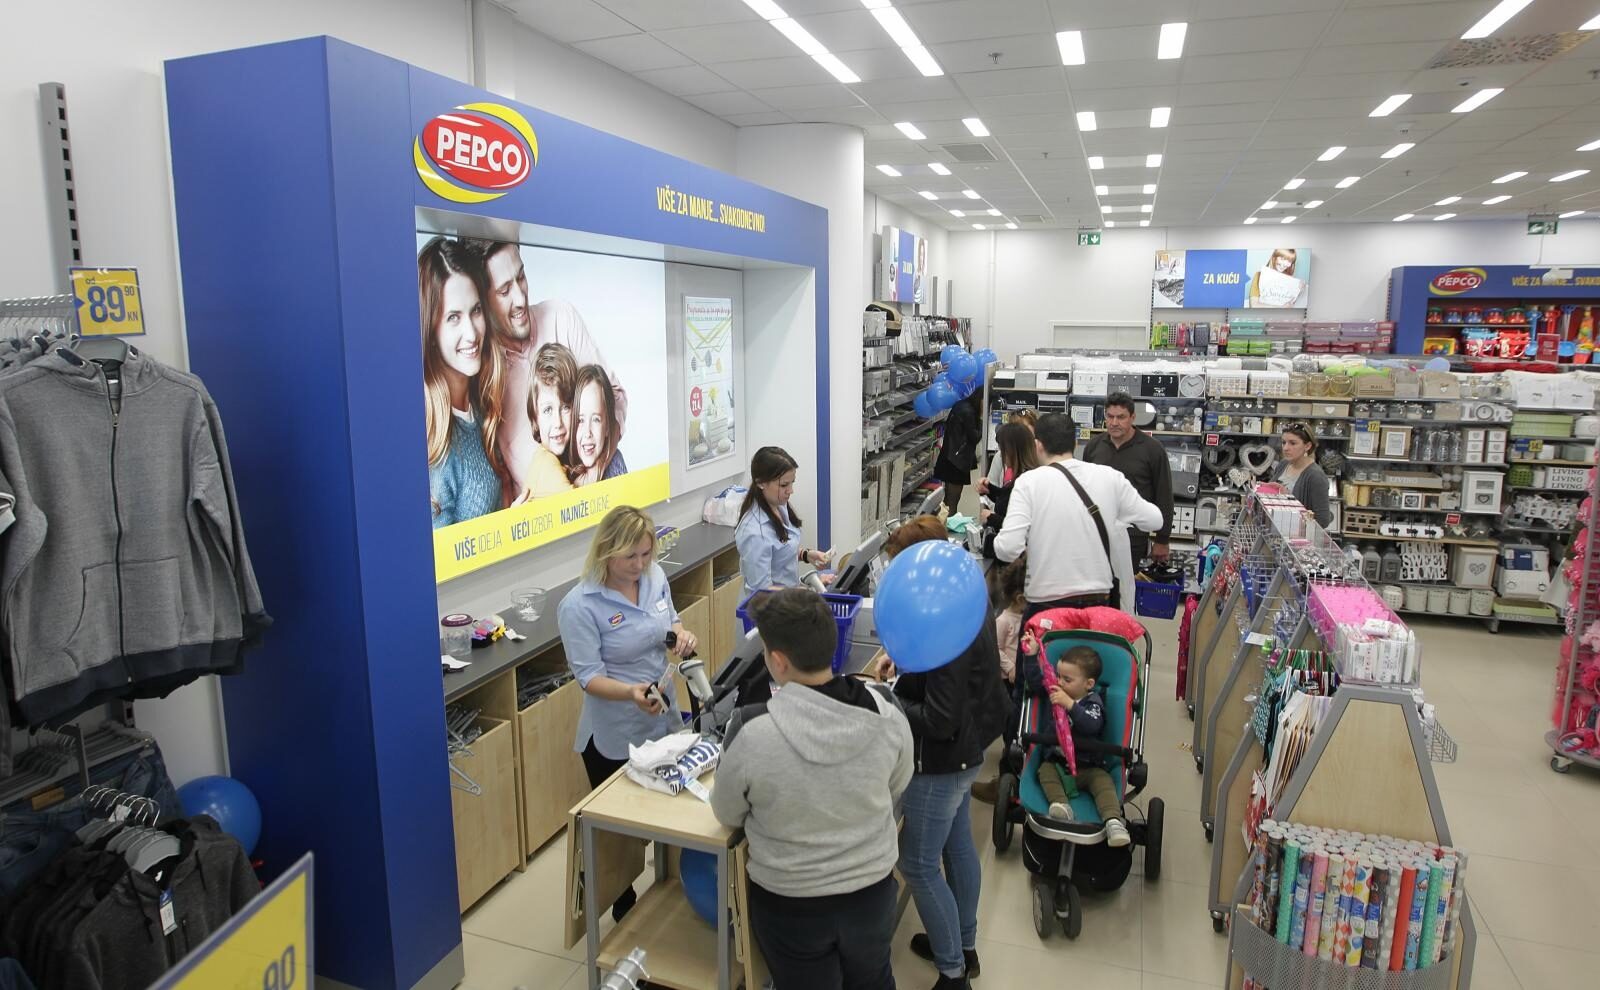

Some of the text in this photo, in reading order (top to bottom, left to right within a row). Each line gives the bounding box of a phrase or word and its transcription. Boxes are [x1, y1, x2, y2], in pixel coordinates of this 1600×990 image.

[437, 126, 522, 175] PEPCO
[656, 184, 676, 213] VIŠE
[677, 191, 689, 216] ZA
[689, 195, 719, 223] MANJE...
[1203, 272, 1240, 285] ZA KUĆU
[1437, 276, 1478, 287] PEPCO
[1529, 276, 1541, 287] ZA
[87, 285, 135, 323] 89 90
[127, 311, 139, 321] KN
[454, 493, 611, 561] VIŠE IDEJA VEĆI IZBOR NAJNIŽE CIJENE
